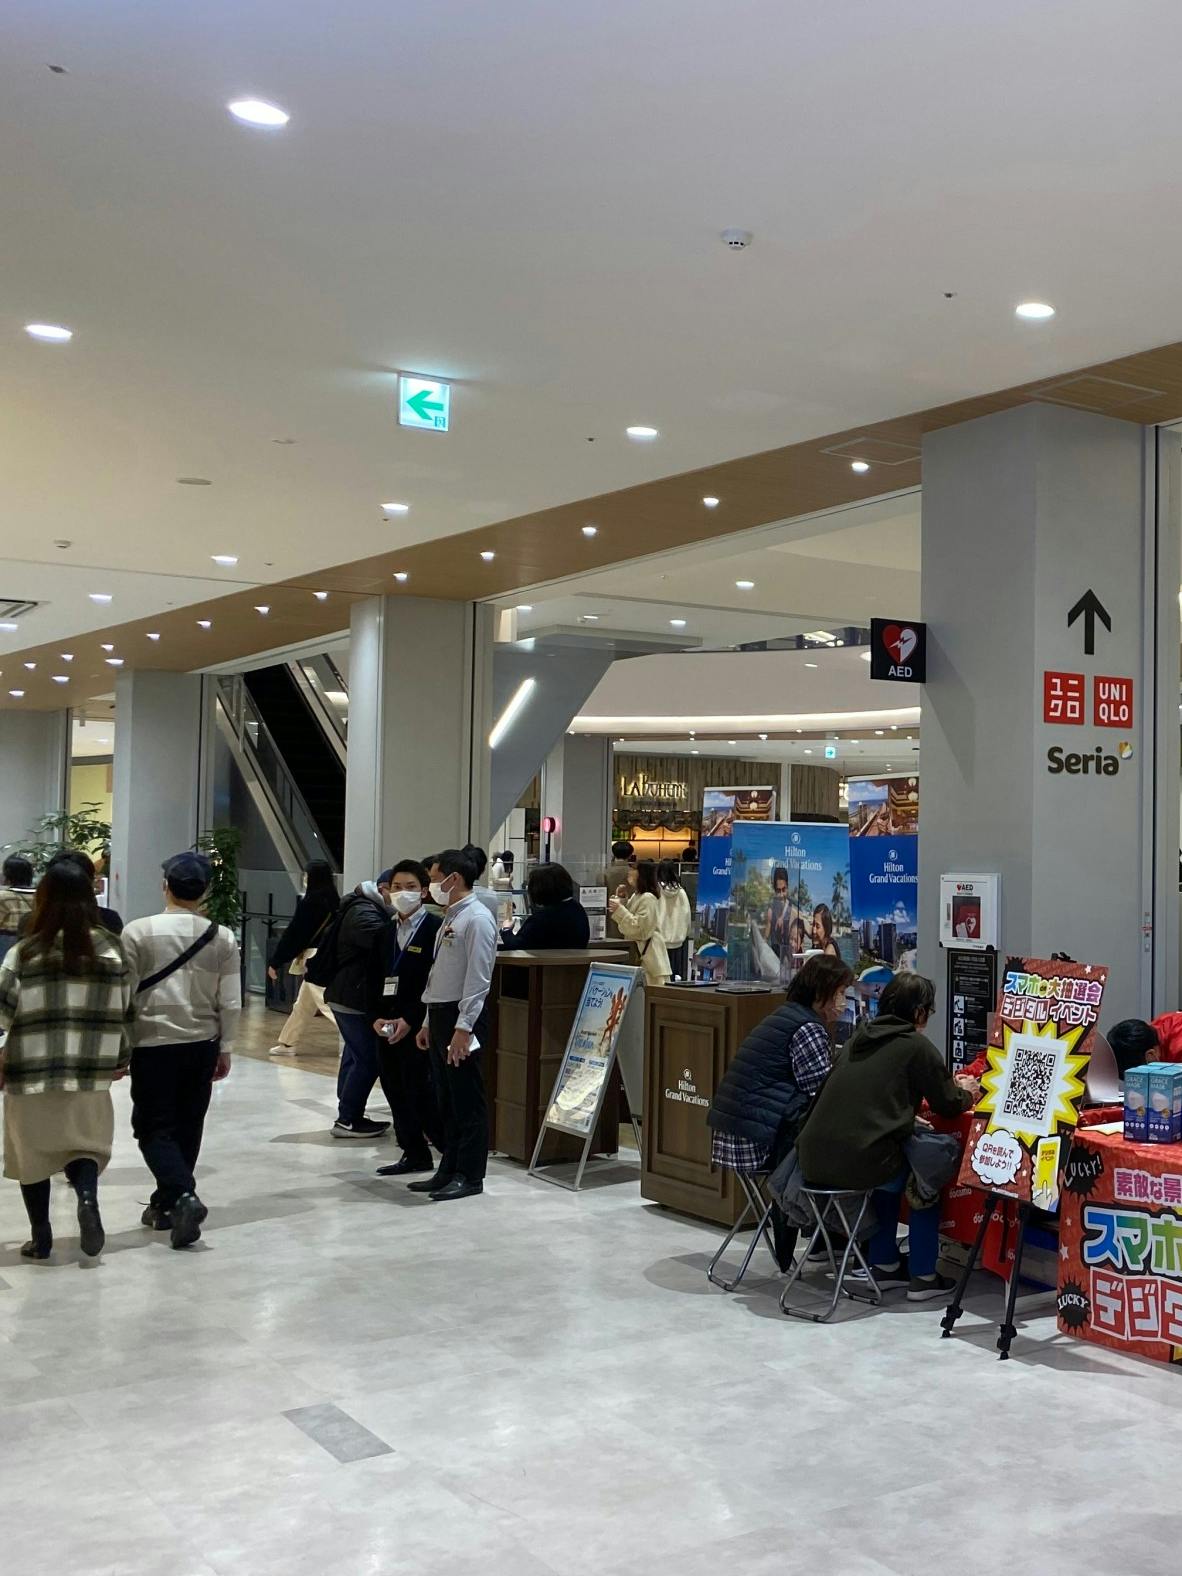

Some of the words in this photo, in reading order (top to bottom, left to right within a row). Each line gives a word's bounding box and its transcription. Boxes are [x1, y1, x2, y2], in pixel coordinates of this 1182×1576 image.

[888, 665, 912, 679] AED
[1047, 746, 1119, 776] Seria
[785, 845, 806, 857] Hilton
[789, 858, 823, 871] Vacations
[883, 861, 904, 873] Hilton
[869, 873, 888, 884] Grand
[678, 1080, 696, 1092] Hilton
[665, 1088, 682, 1101] Grand
[682, 1091, 710, 1107] Vacations
[1063, 1155, 1102, 1188] LUCKY!
[1057, 1293, 1088, 1310] LUCKY
